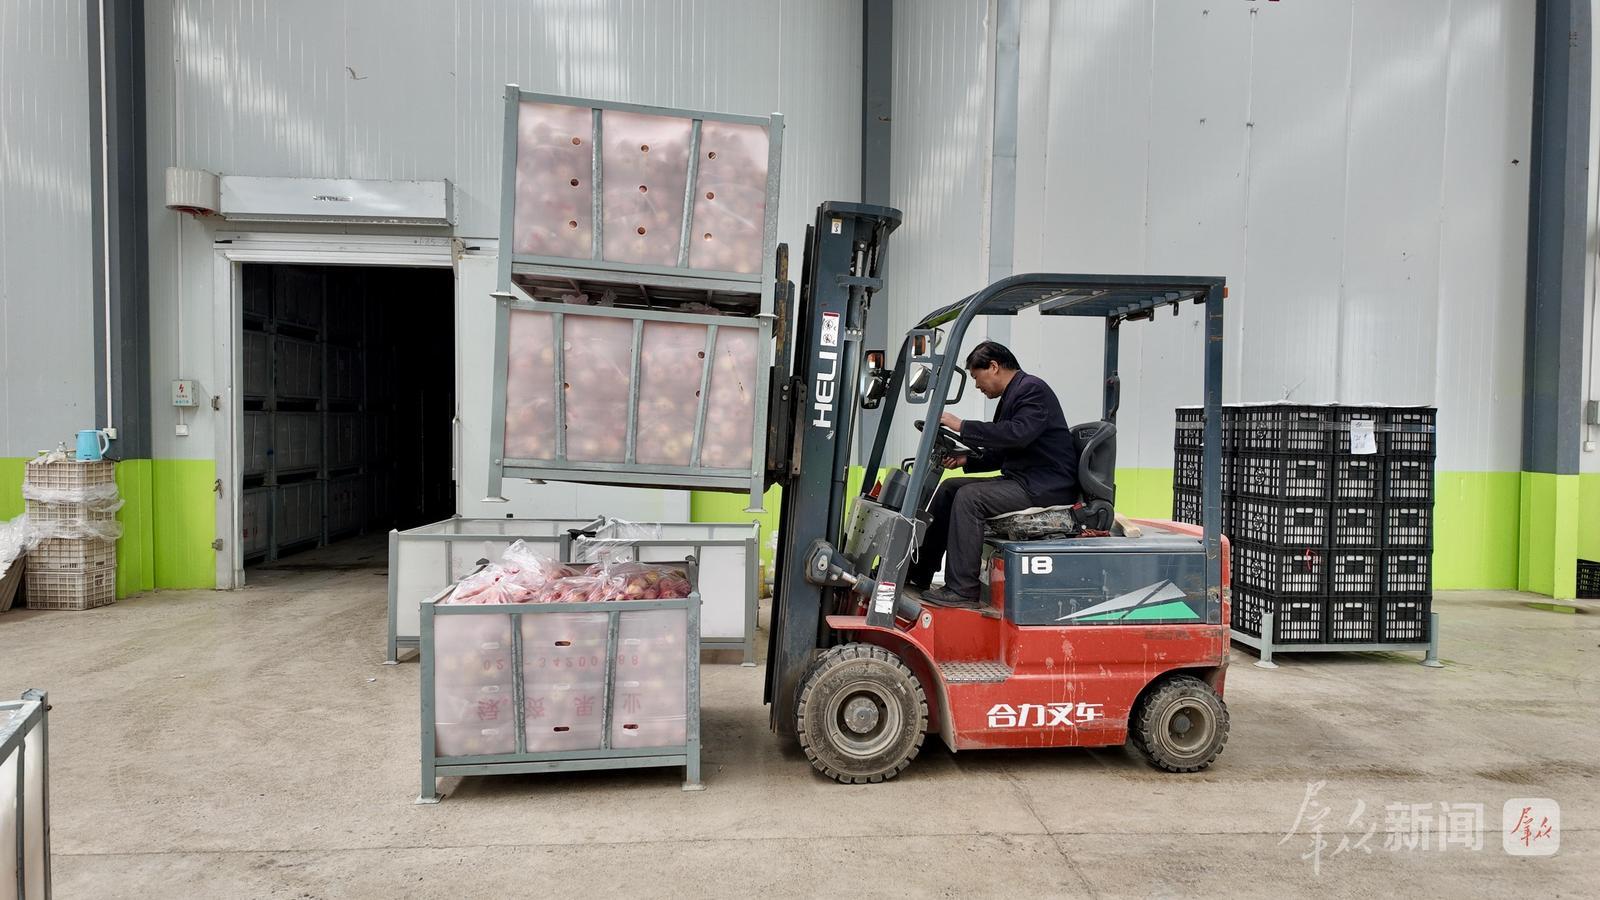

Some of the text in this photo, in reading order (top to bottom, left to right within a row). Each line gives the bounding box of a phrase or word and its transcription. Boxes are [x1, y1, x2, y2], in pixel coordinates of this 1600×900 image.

[813, 351, 838, 428] HELI
[1021, 556, 1053, 575] 18
[986, 702, 1104, 728] 合力叉车
